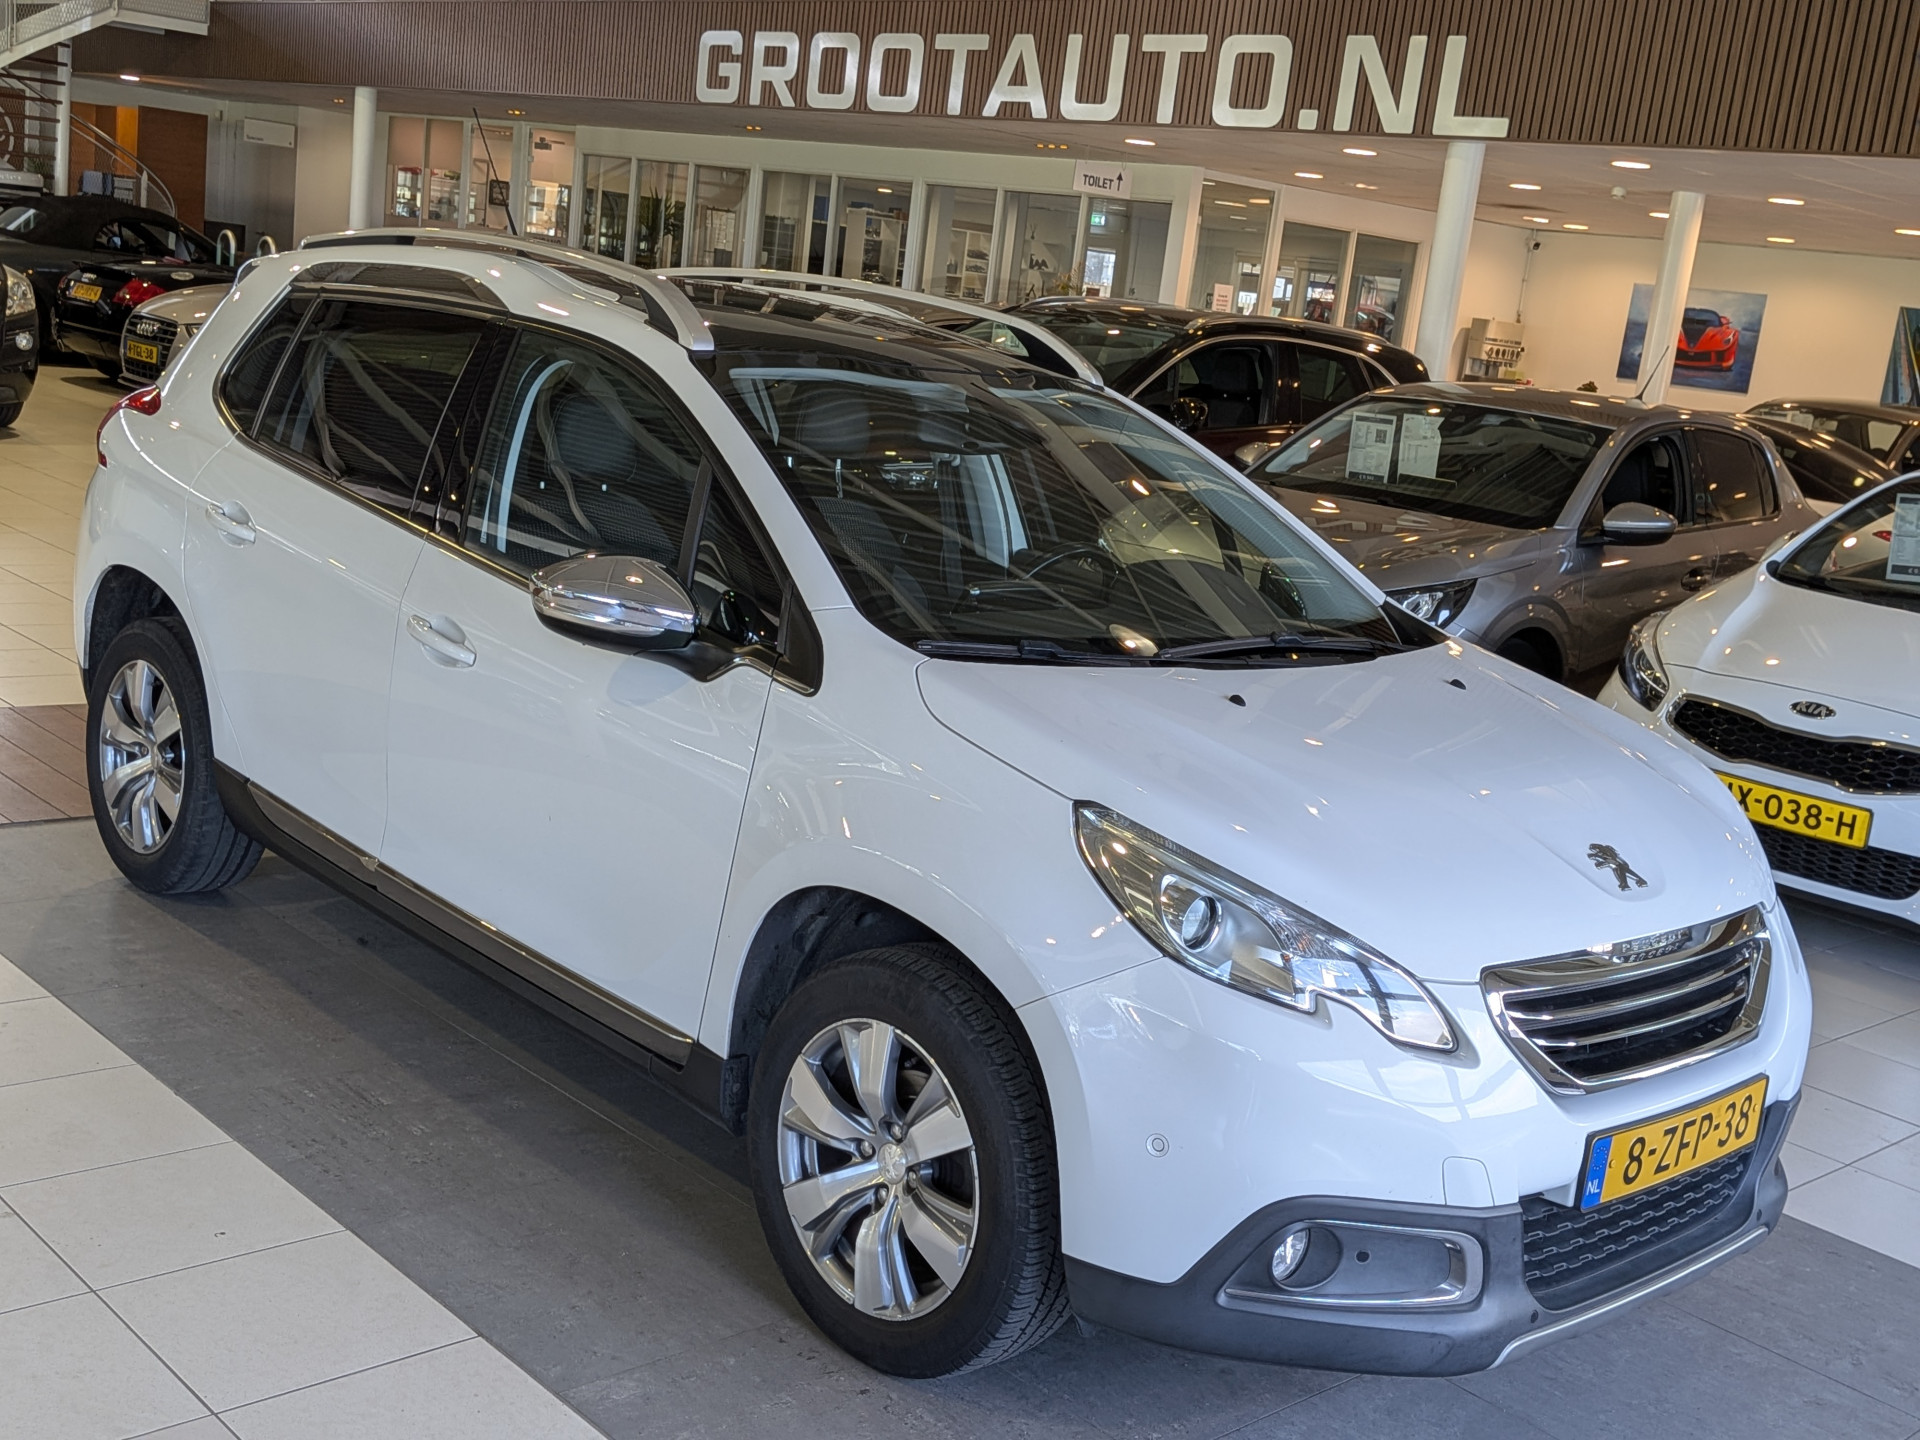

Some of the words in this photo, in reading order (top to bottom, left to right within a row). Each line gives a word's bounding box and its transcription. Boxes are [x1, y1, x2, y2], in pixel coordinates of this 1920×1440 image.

[695, 30, 1510, 138] GROOTAUTO.NL
[1083, 173, 1115, 190] TOILET
[1796, 700, 1827, 717] KIA
[1622, 1094, 1753, 1186] 8-ZFP-38
[1586, 1178, 1600, 1196] NL
